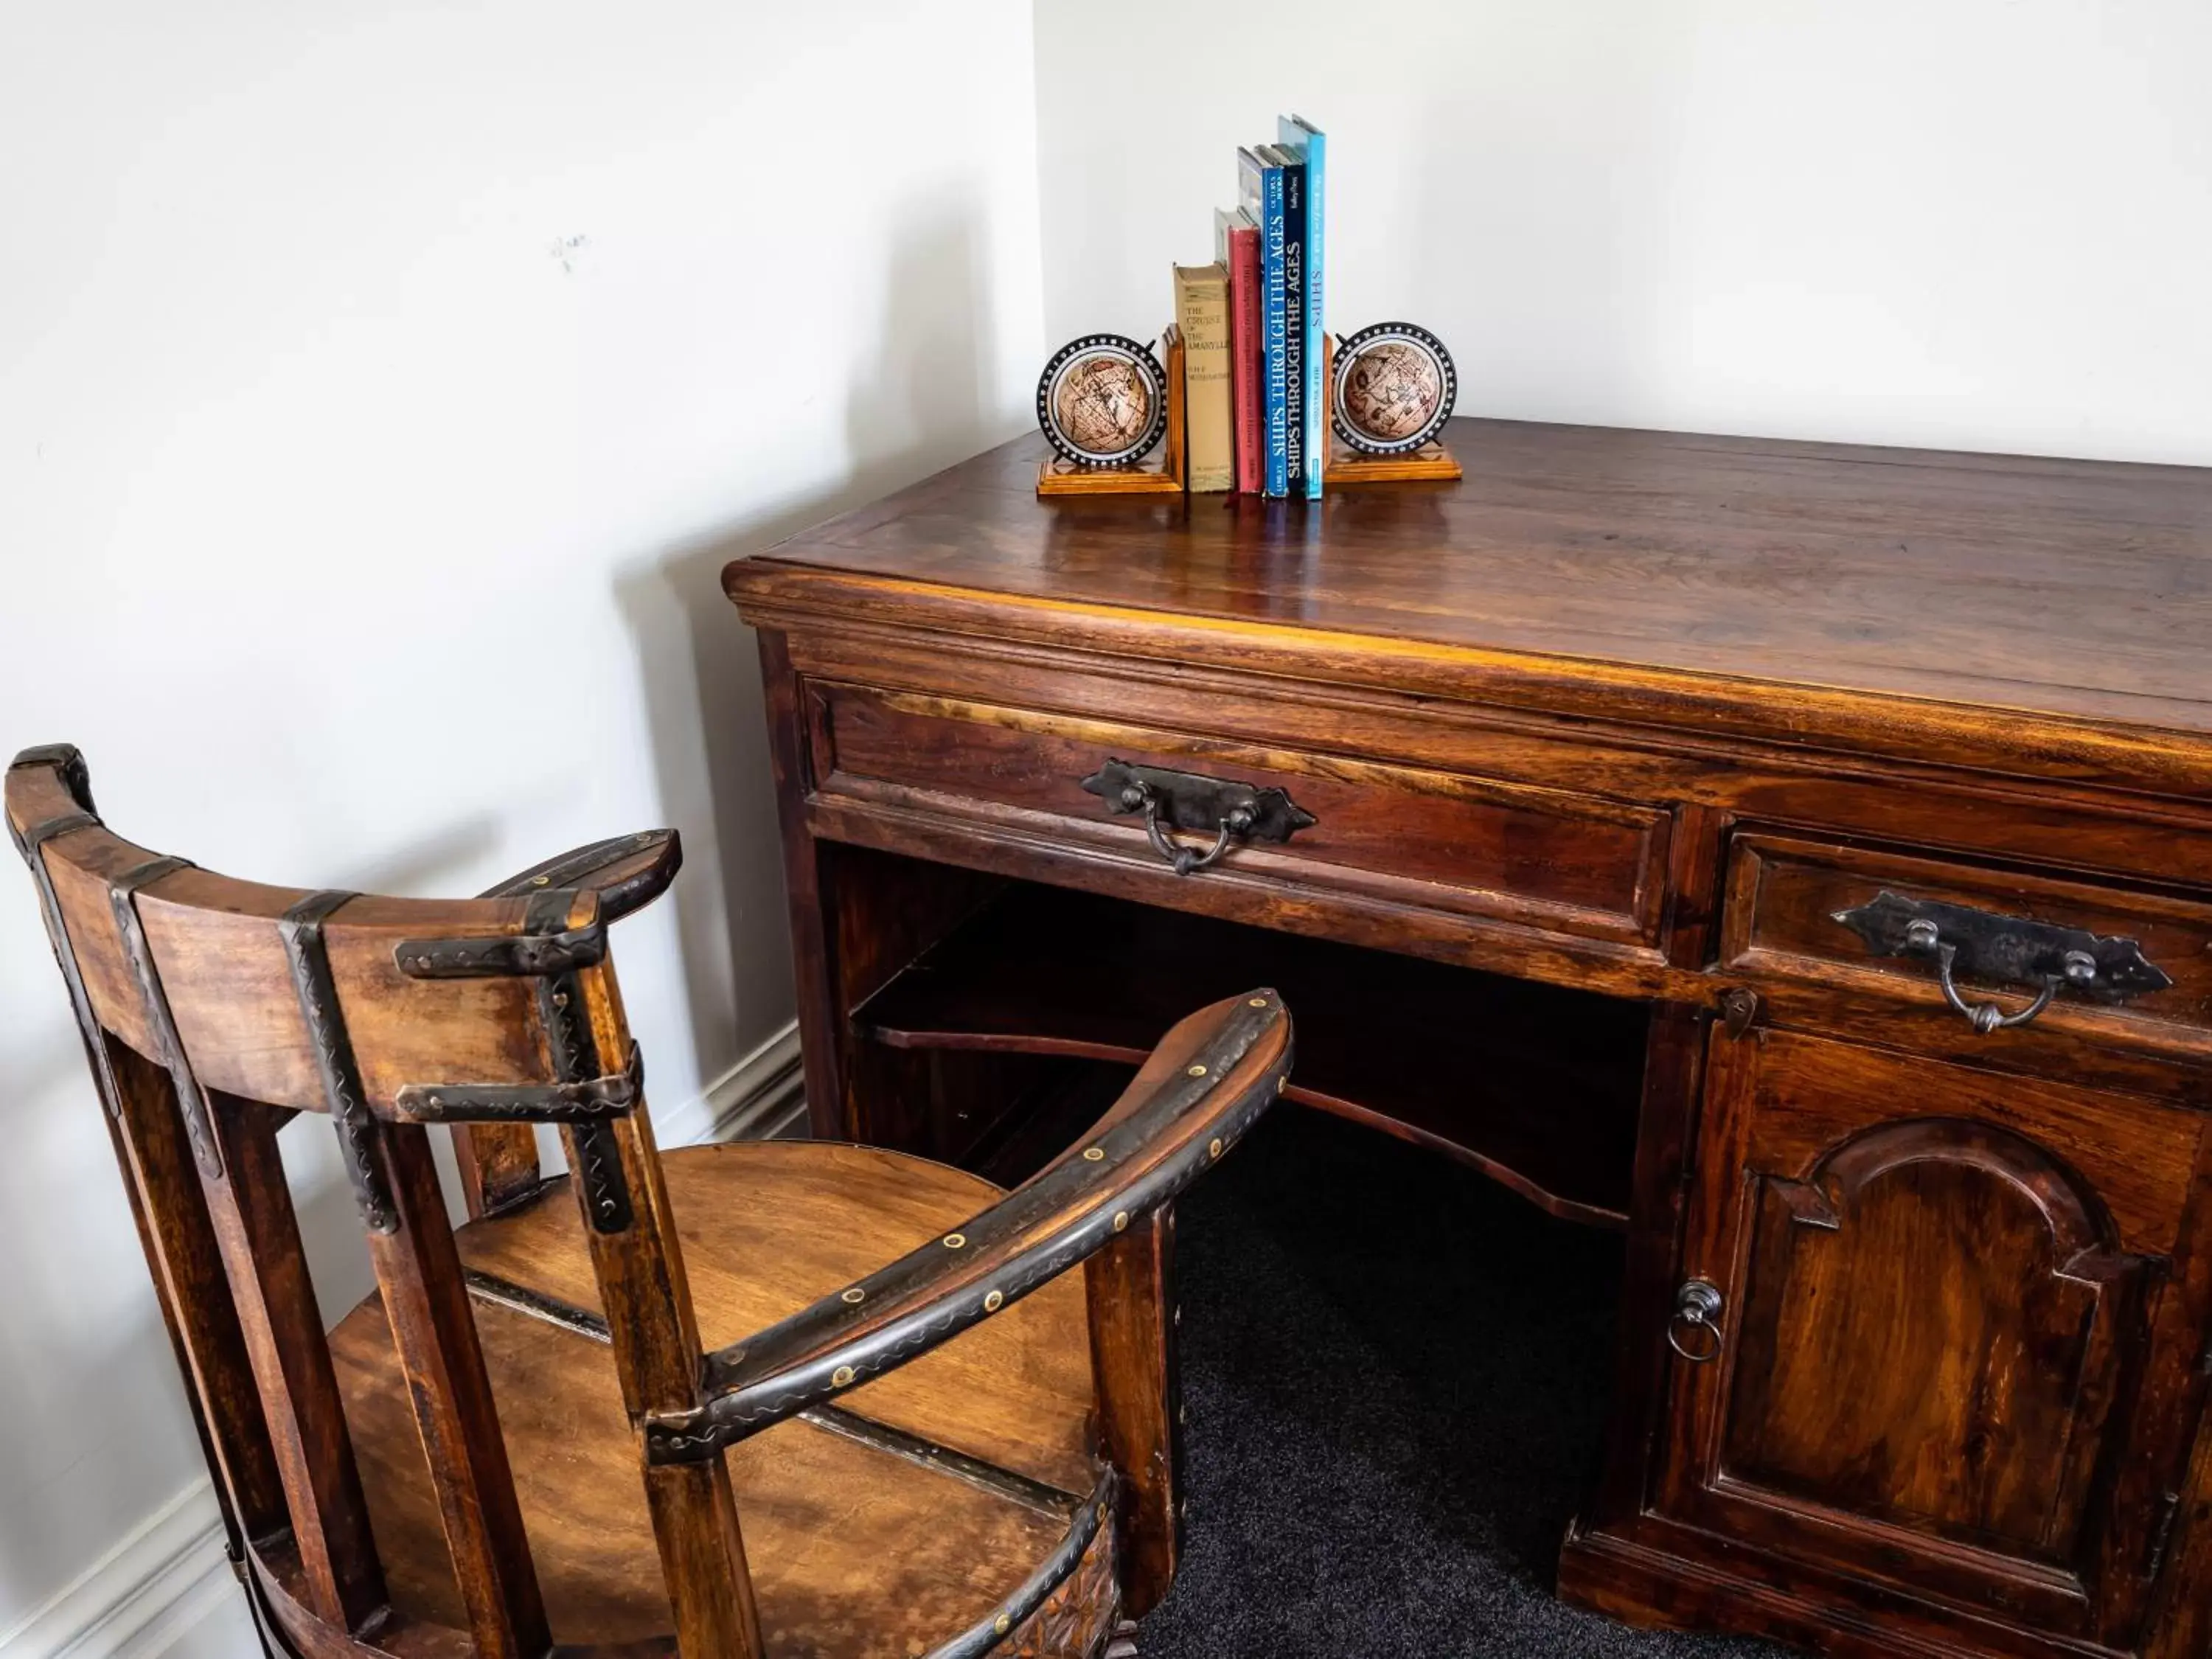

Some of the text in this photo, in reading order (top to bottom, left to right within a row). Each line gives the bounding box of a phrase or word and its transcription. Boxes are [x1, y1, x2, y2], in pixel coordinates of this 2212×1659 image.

[1187, 307, 1203, 316] THE
[1270, 215, 1286, 457] SHIPS THROUGH THE AGES
[1287, 241, 1301, 479] SHIPS THROUGH THE AGES
[1312, 270, 1322, 327] SHIPS
